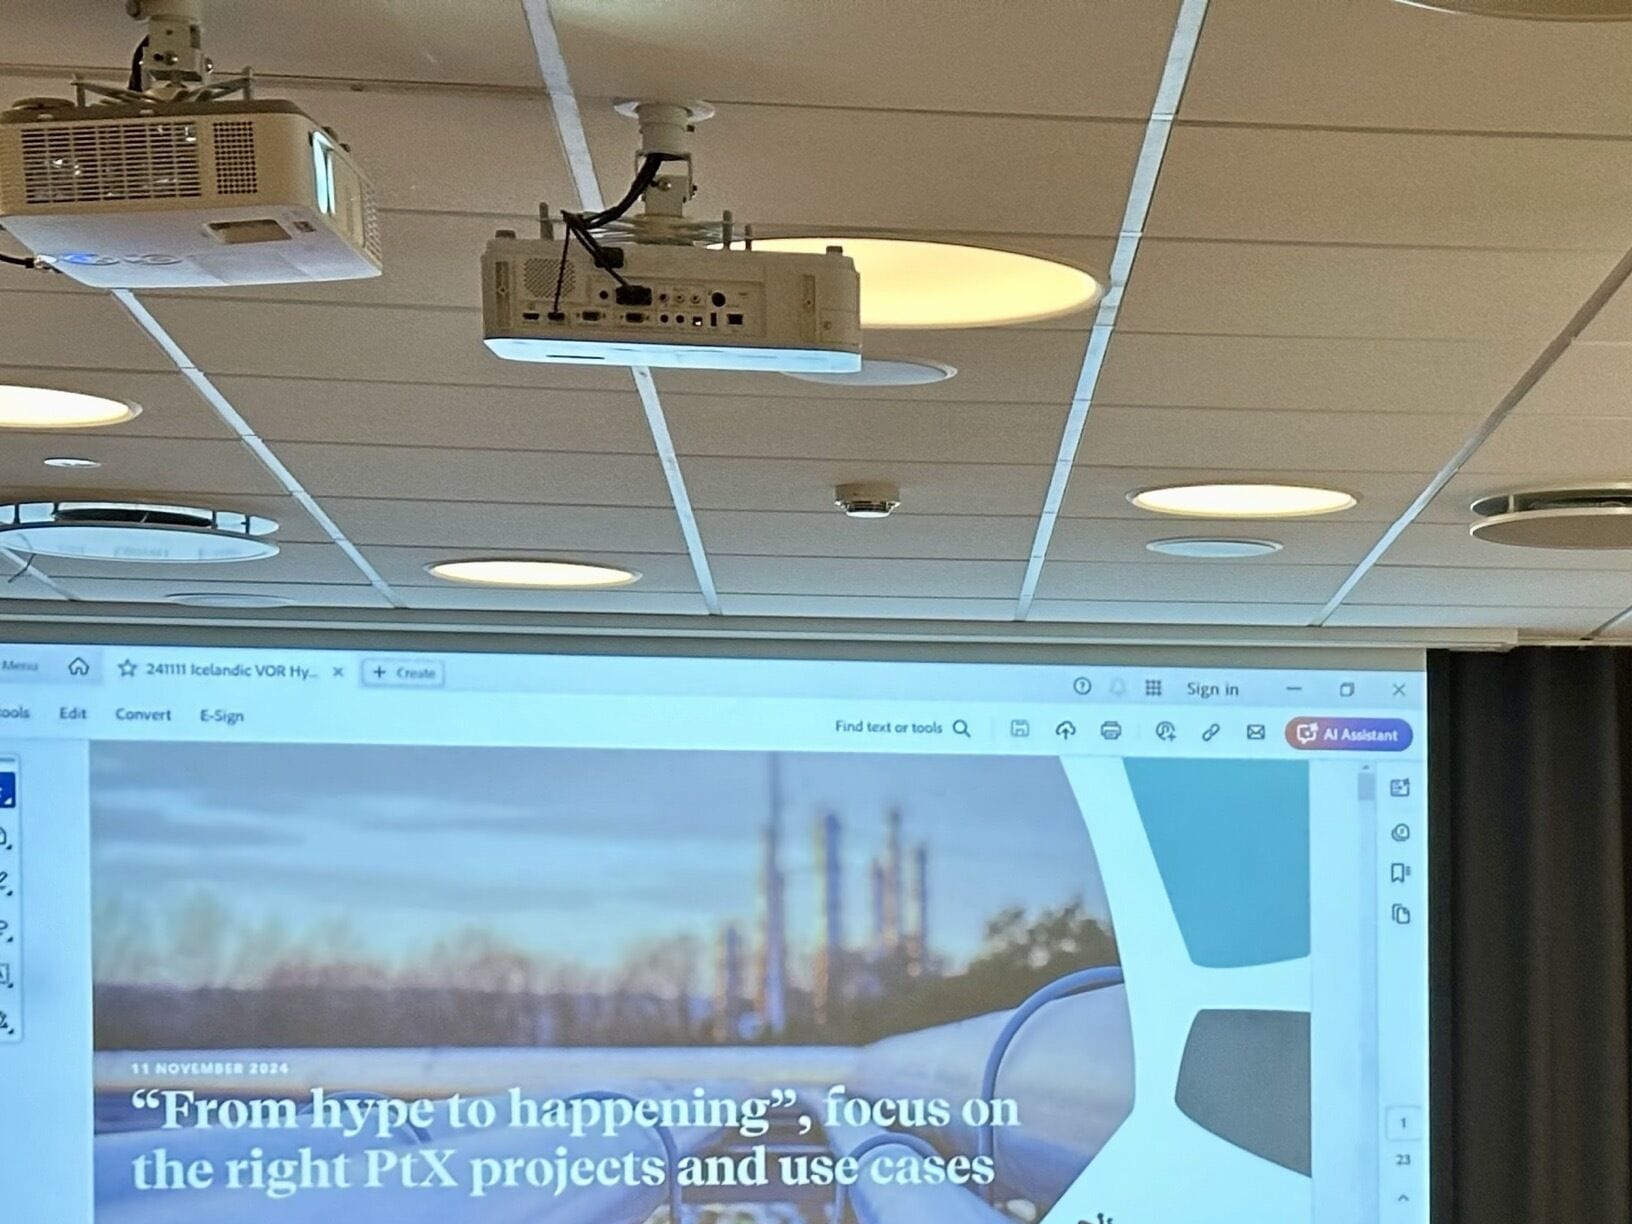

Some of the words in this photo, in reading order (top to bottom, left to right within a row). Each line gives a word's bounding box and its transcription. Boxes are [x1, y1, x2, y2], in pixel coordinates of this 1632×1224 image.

[146, 663, 187, 676] 241111
[190, 663, 251, 677] Icelandic
[254, 665, 286, 678] VOR
[396, 667, 436, 680] Create
[1187, 682, 1220, 698] Sign
[1224, 682, 1239, 696] in
[59, 707, 87, 720] Edit
[115, 708, 171, 721] Convert
[200, 709, 244, 726] E-Sign
[835, 720, 863, 733] Find
[867, 721, 891, 733] text
[895, 725, 909, 733] or
[912, 721, 943, 734] tools
[1324, 729, 1338, 741] AI
[1341, 729, 1398, 742] Assistant
[131, 1064, 149, 1074] 11
[155, 1063, 244, 1075] NOVEMBER
[249, 1063, 289, 1075] 2024
[310, 1088, 434, 1137] hype
[448, 1094, 496, 1128] to
[823, 1084, 950, 1128] focus
[962, 1098, 1021, 1127] on
[132, 1148, 213, 1190] the
[225, 1147, 350, 1198] right
[363, 1149, 458, 1188] PtX
[469, 1146, 665, 1197] projects
[677, 1146, 768, 1186] and
[778, 1157, 860, 1186] use
[870, 1156, 996, 1185] cases
